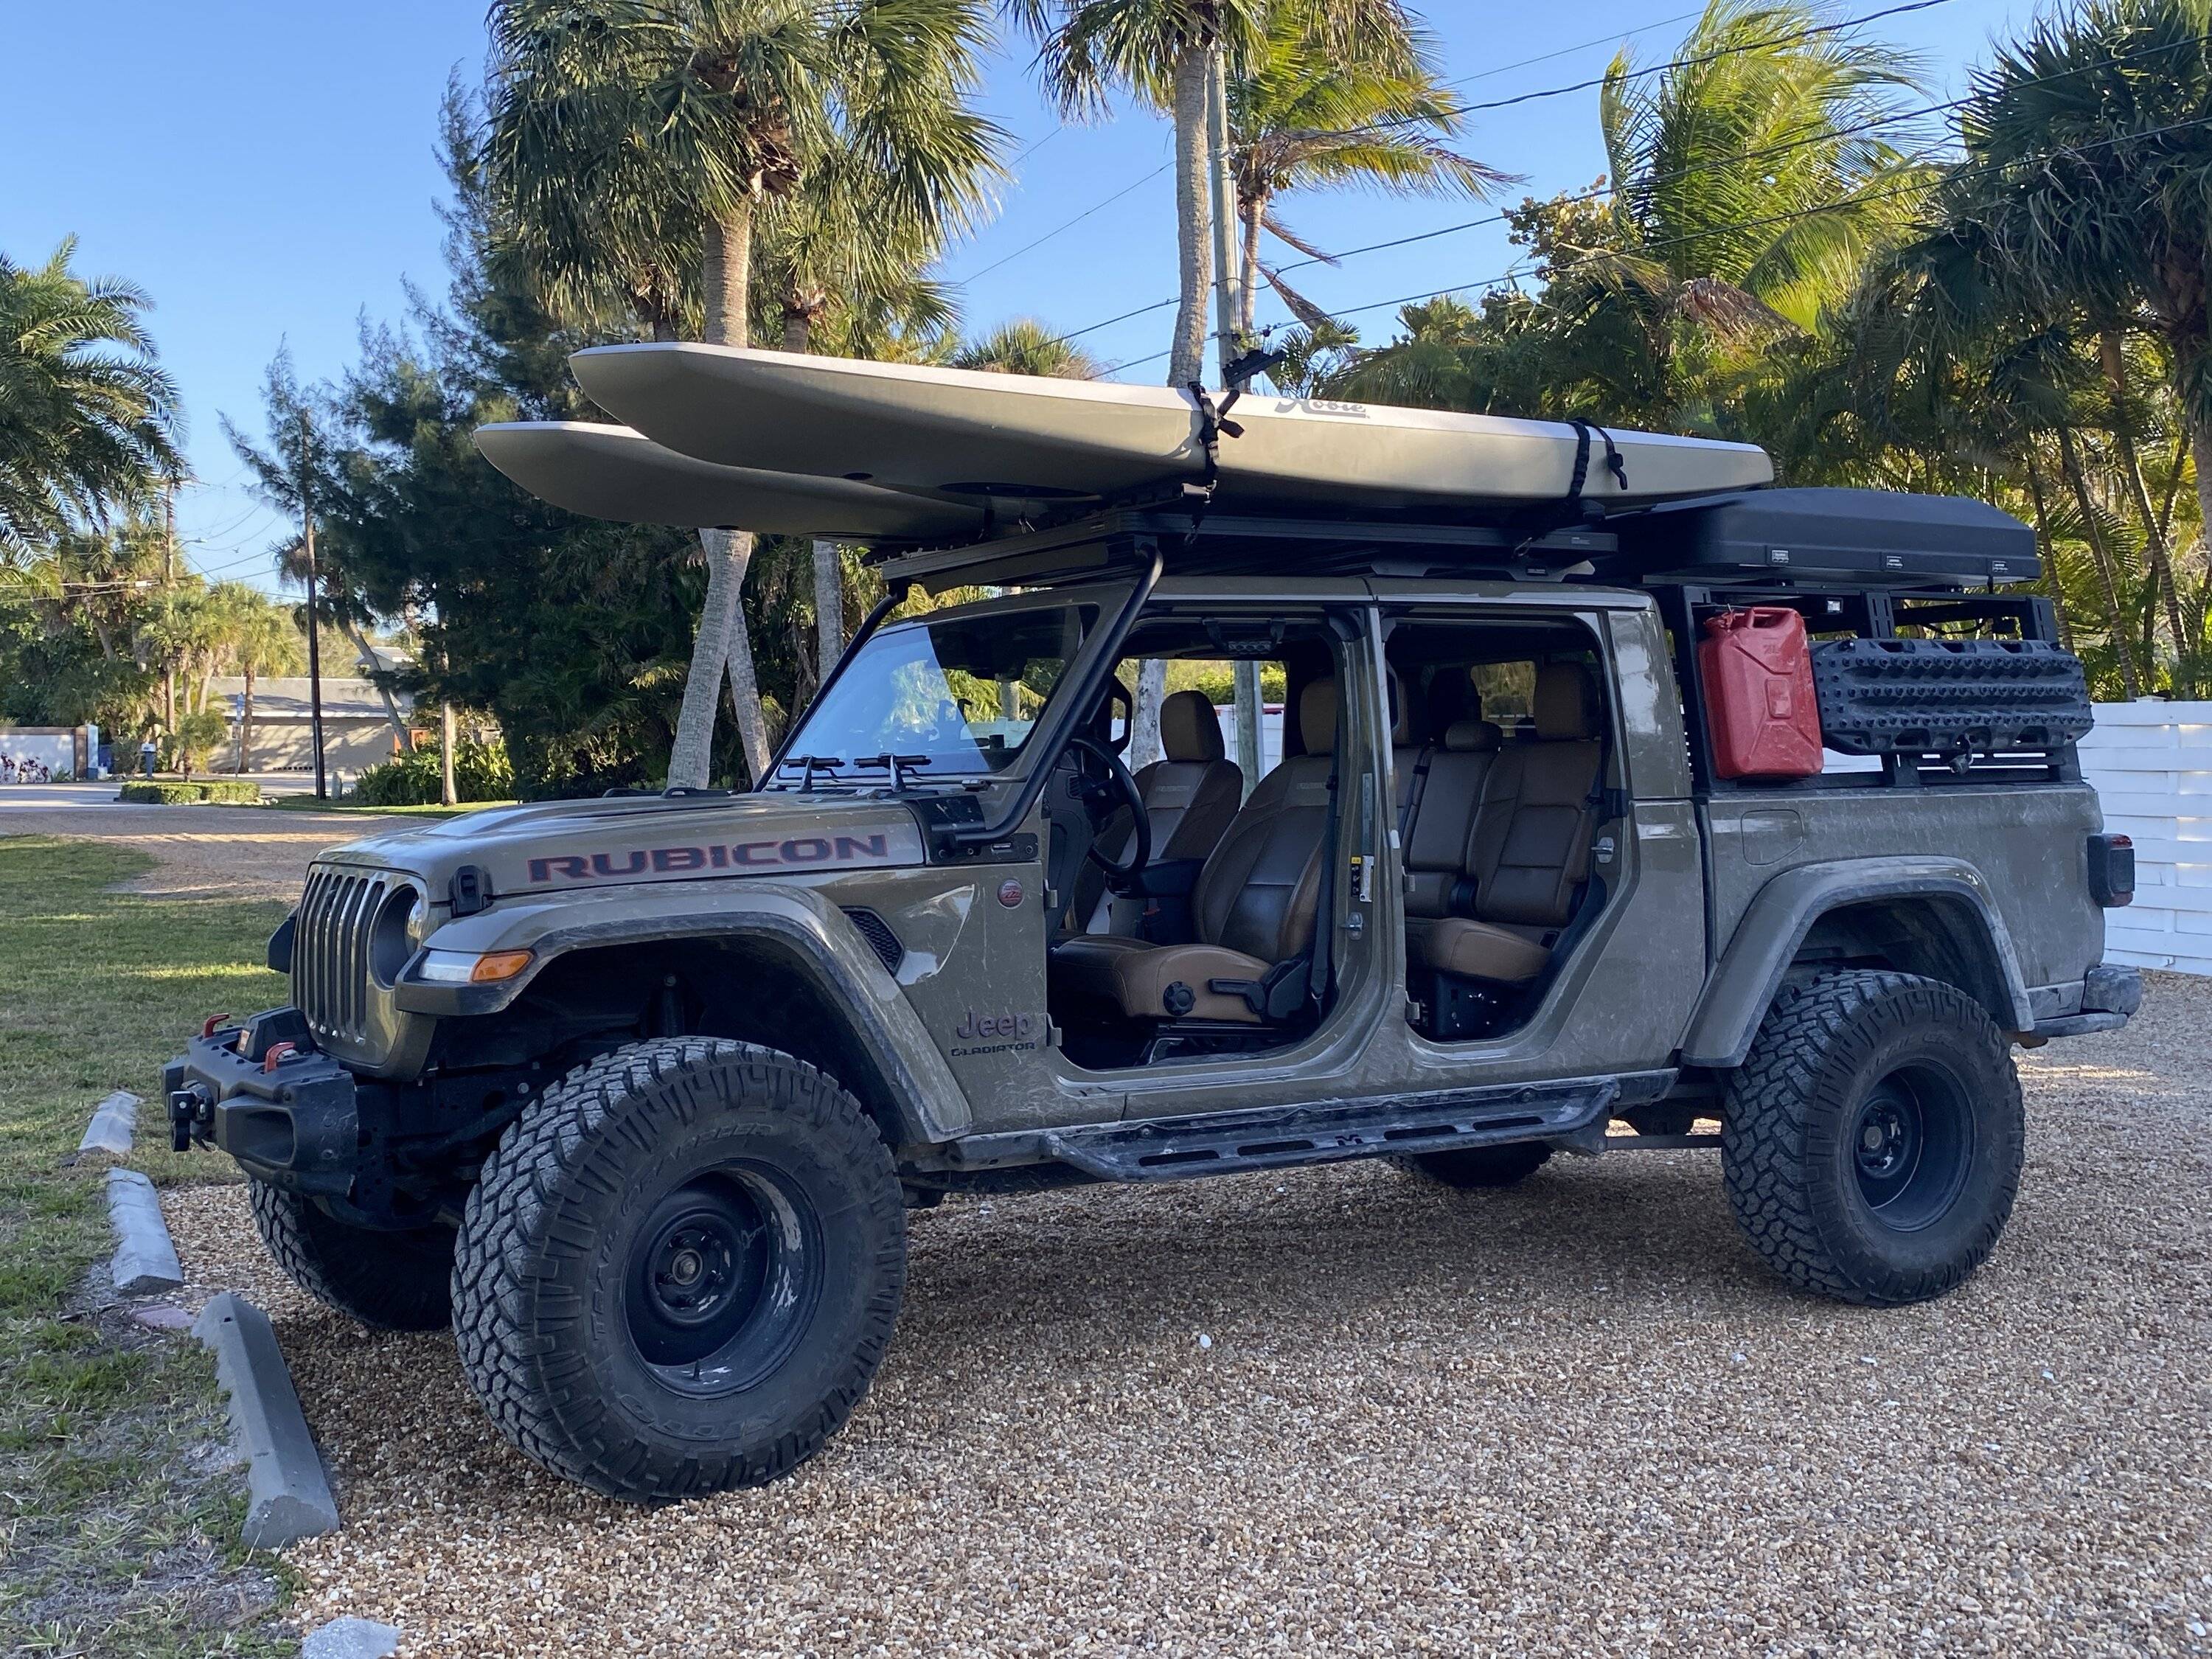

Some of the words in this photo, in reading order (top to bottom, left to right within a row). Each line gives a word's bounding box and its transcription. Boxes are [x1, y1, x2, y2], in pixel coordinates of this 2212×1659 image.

[528, 834, 888, 883] RUBICON
[956, 1012, 1033, 1040] Jeep
[950, 1042, 1036, 1057] GLADIATOR
